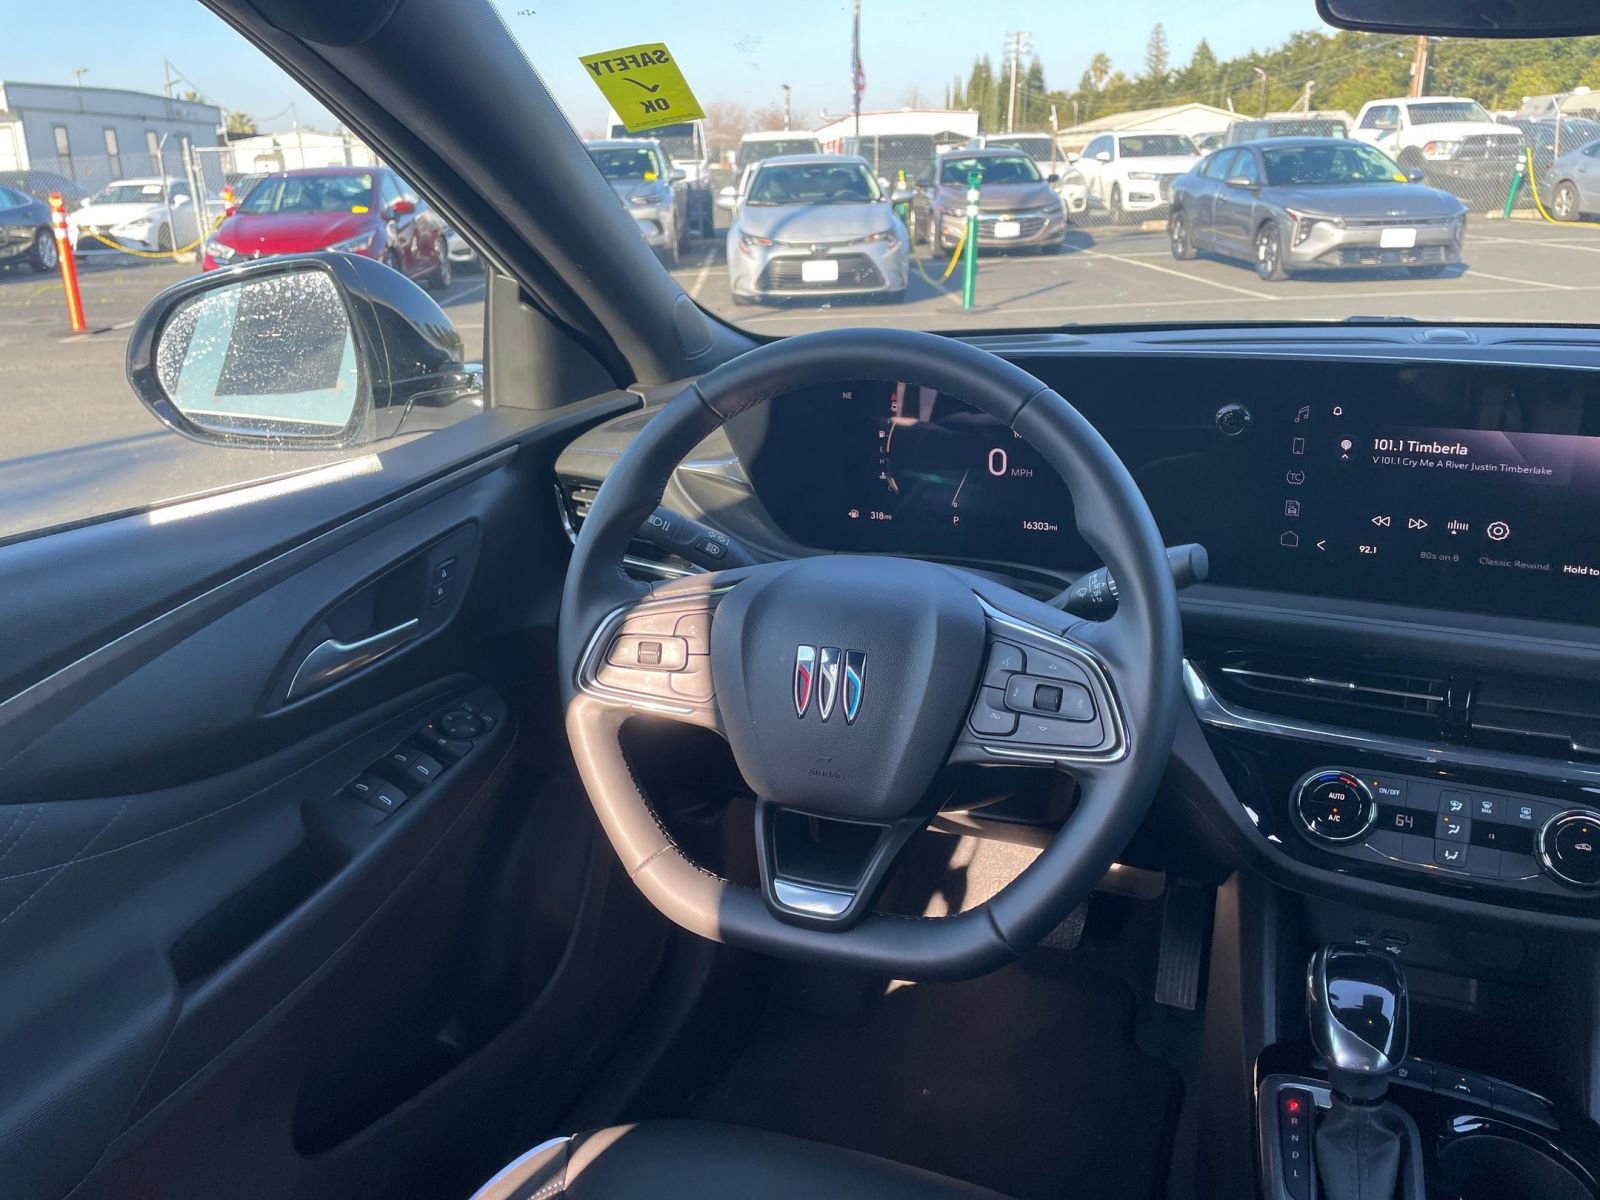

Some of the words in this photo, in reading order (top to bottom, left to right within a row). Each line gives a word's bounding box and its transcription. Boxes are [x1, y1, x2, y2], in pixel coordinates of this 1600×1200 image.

[842, 391, 853, 400] NE
[1374, 438, 1404, 452] 101.1
[1407, 440, 1468, 456] Timberla
[988, 448, 1007, 476] 0
[1011, 468, 1033, 478] MPH
[1402, 457, 1418, 468] Cry
[1419, 458, 1435, 468] Me
[1436, 459, 1444, 468] A
[1445, 460, 1469, 470] River
[1470, 462, 1497, 472] Justin
[1499, 463, 1553, 476] Timberlake
[1289, 472, 1302, 482] TC
[953, 516, 960, 525] P
[1359, 545, 1377, 554] 92.1
[1420, 551, 1437, 560] 80s
[1452, 554, 1460, 562] 8
[1479, 556, 1512, 568] Classic
[1514, 559, 1551, 571] Rewind
[1563, 564, 1587, 575] Hold
[1589, 567, 1600, 576] to
[1328, 791, 1345, 801] AUTO
[1379, 787, 1400, 796] ON/OFF
[1328, 814, 1341, 822] A/C
[1395, 813, 1414, 829] 64
[1291, 1117, 1298, 1125] R
[1291, 1134, 1299, 1142] N
[1292, 1150, 1300, 1159] D
[1293, 1169, 1299, 1177] L
